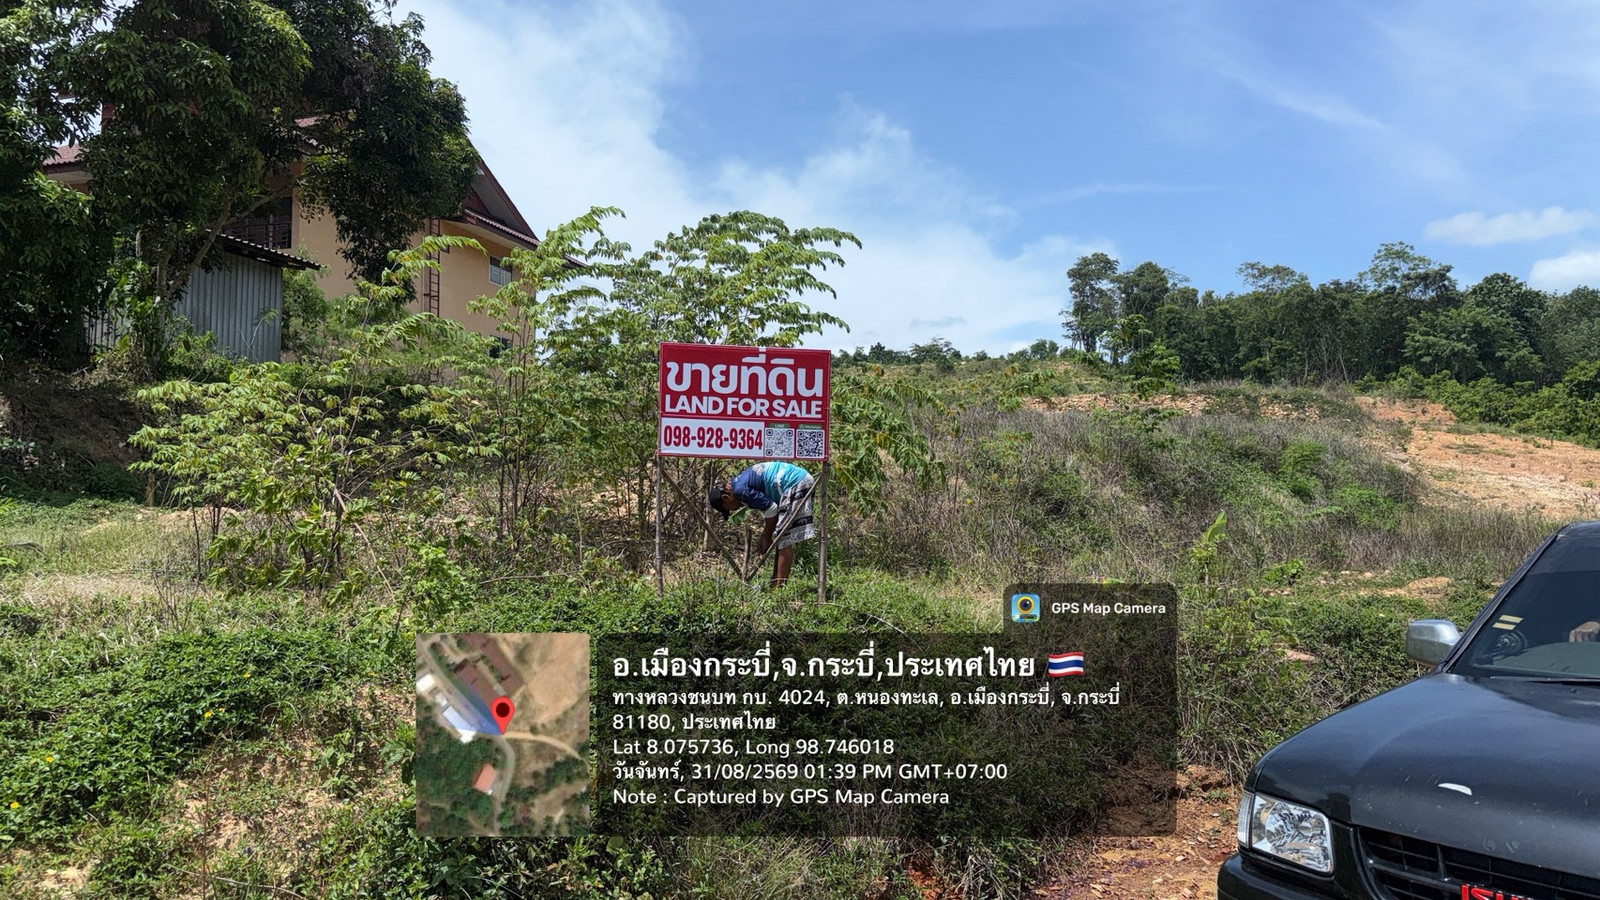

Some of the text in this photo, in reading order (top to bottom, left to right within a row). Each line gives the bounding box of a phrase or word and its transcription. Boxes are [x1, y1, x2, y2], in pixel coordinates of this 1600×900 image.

[666, 347, 824, 398] ขายที่ดิน
[665, 394, 823, 419] LAND FOR SALE
[663, 425, 763, 450] 098-928-9364
